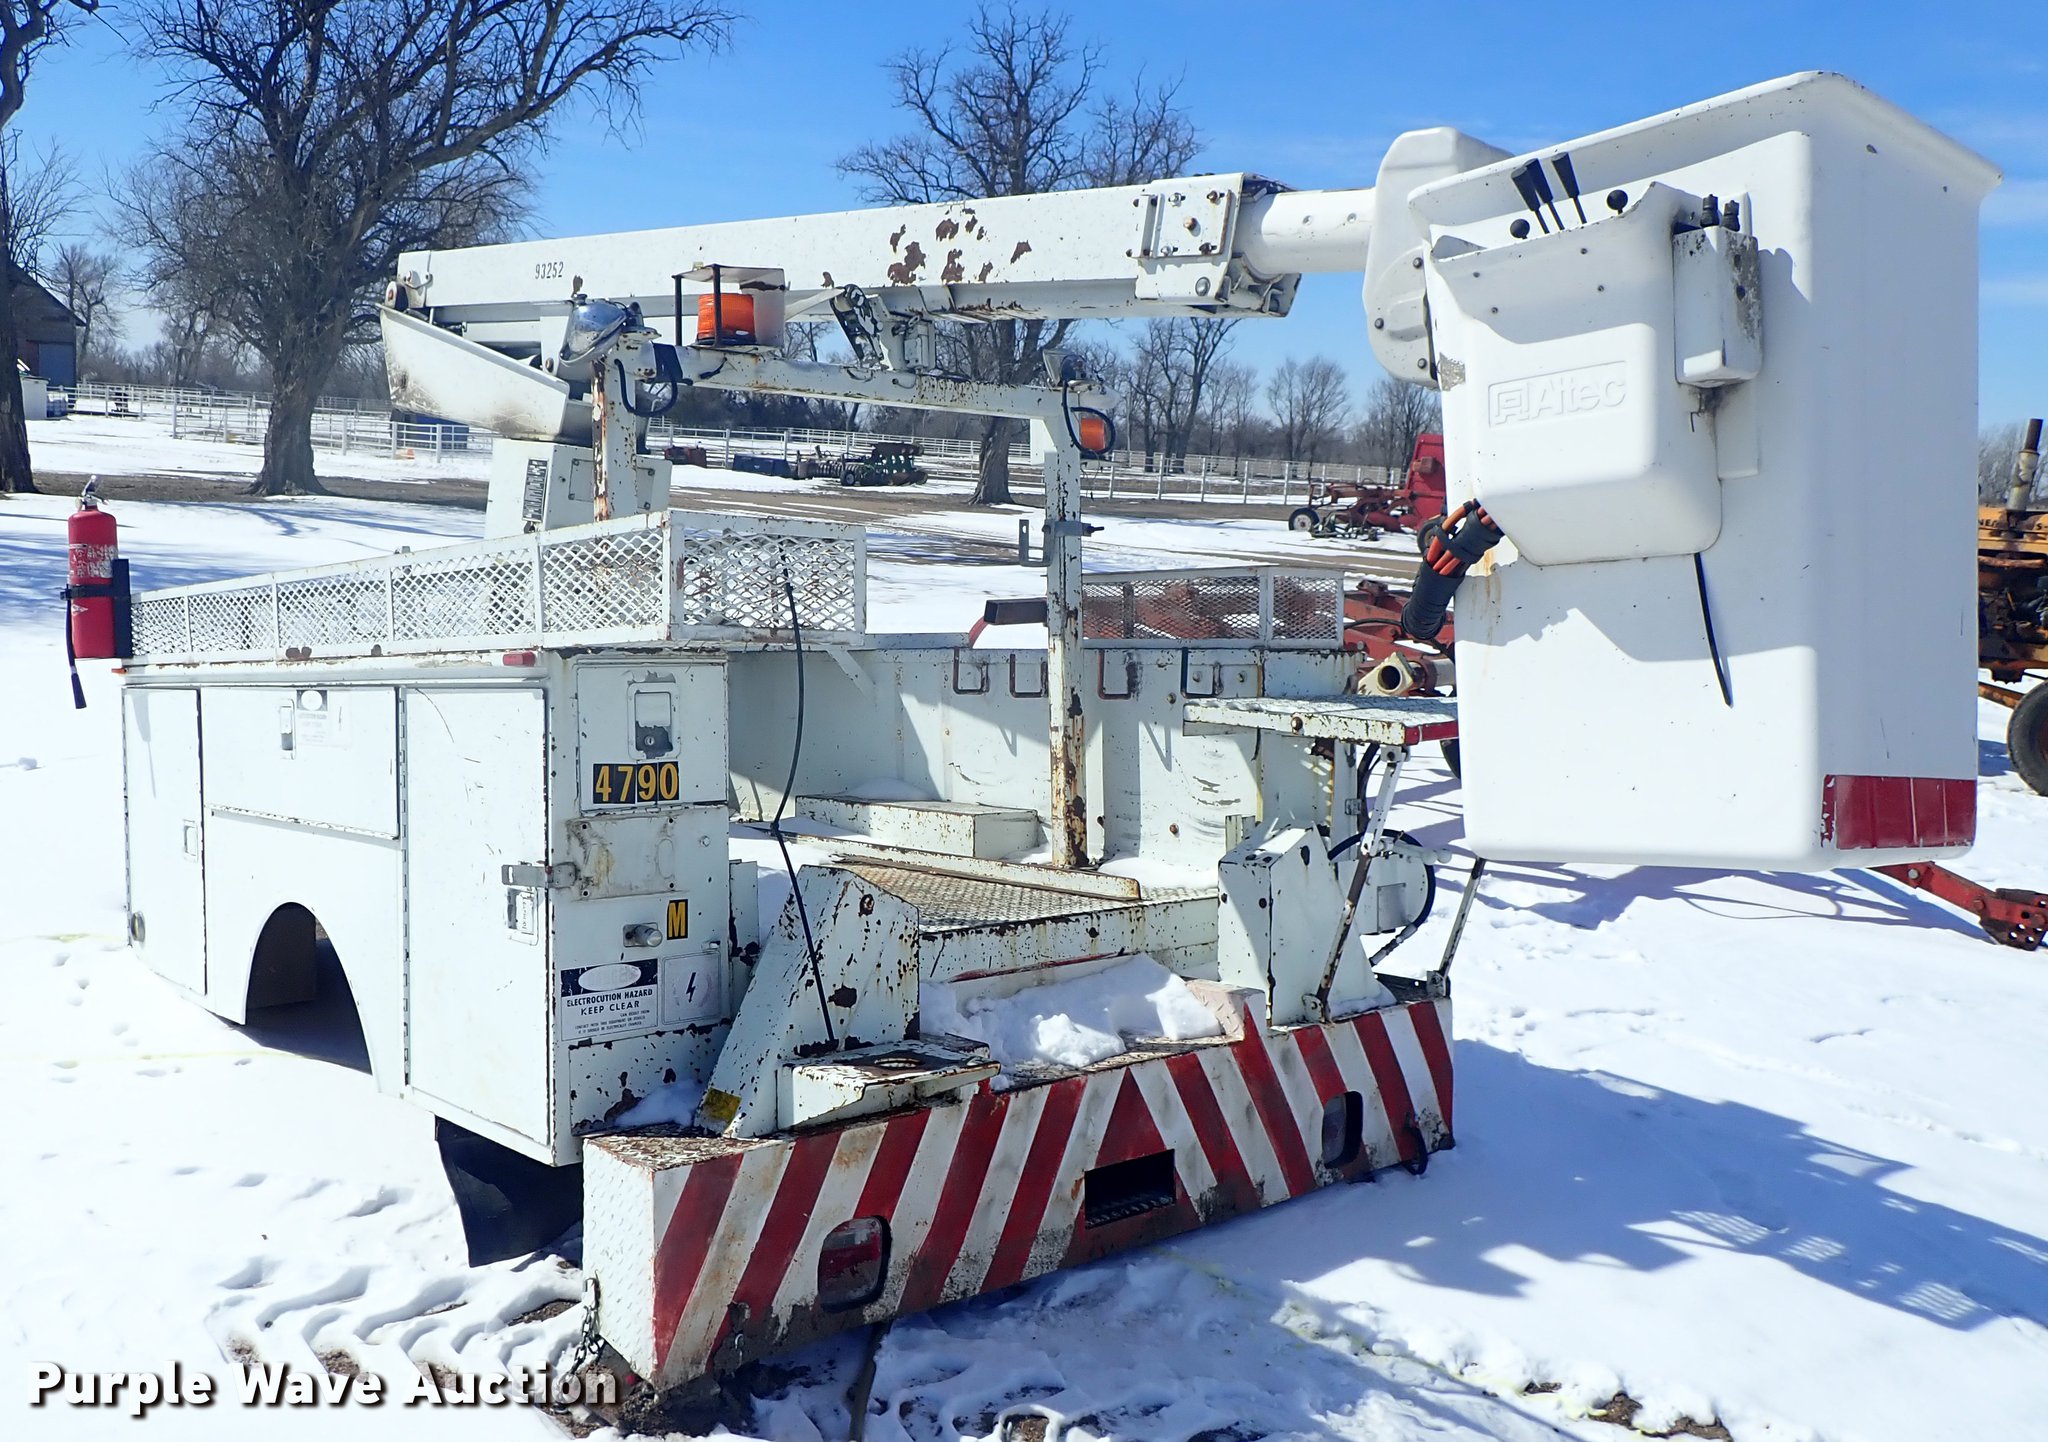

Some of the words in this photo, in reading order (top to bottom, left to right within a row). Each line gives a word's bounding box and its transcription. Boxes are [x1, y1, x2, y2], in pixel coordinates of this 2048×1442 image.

[535, 261, 564, 279] 93252
[1530, 376, 1627, 420] Altec
[595, 763, 679, 802] 4790
[668, 902, 686, 938] M
[567, 993, 622, 1007] ELECTROCUTION
[624, 988, 653, 999] HAZARD
[581, 1005, 605, 1016] KEEP
[609, 1000, 640, 1012] CLEAR
